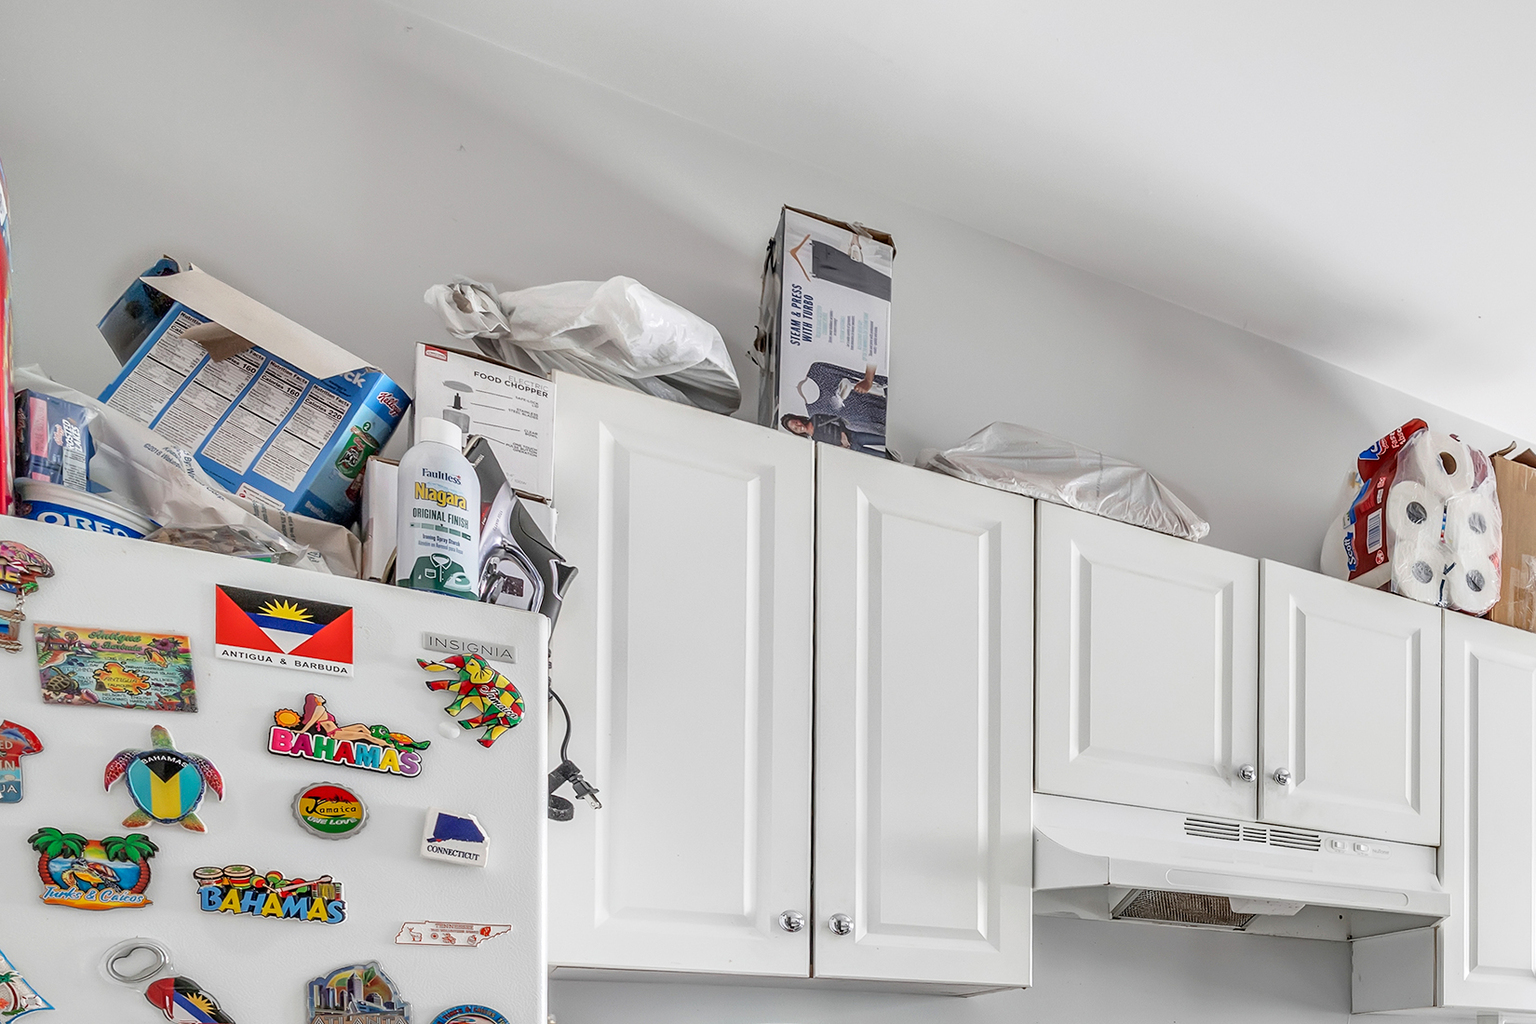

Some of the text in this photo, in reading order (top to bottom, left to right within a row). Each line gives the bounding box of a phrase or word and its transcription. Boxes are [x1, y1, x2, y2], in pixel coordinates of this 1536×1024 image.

[791, 283, 802, 309] PRESS
[802, 294, 814, 342] WITH TURBO
[789, 319, 802, 347] STEAM
[286, 386, 300, 398] 160
[473, 371, 549, 398] FOOD CHOPPER
[509, 375, 549, 391] ELECTRIC
[422, 468, 462, 485] Faultless
[415, 482, 467, 511] Niagara
[413, 507, 469, 529] ORIGINAL FINISH
[88, 630, 142, 643] Antigua
[429, 636, 513, 660] INSIGNIA
[221, 649, 273, 663] ANTIGUA
[294, 660, 348, 674] BARBUDA
[480, 685, 519, 719] Jamaica
[141, 755, 188, 768] BAHAMAS
[271, 727, 420, 775] BAHAMAS
[305, 796, 357, 817] Jamaica
[307, 816, 358, 826] ONE LOVE
[427, 844, 480, 861] CONNECTICUT
[43, 886, 144, 903] Turks & Caicos
[200, 886, 344, 924] BAHAMAS
